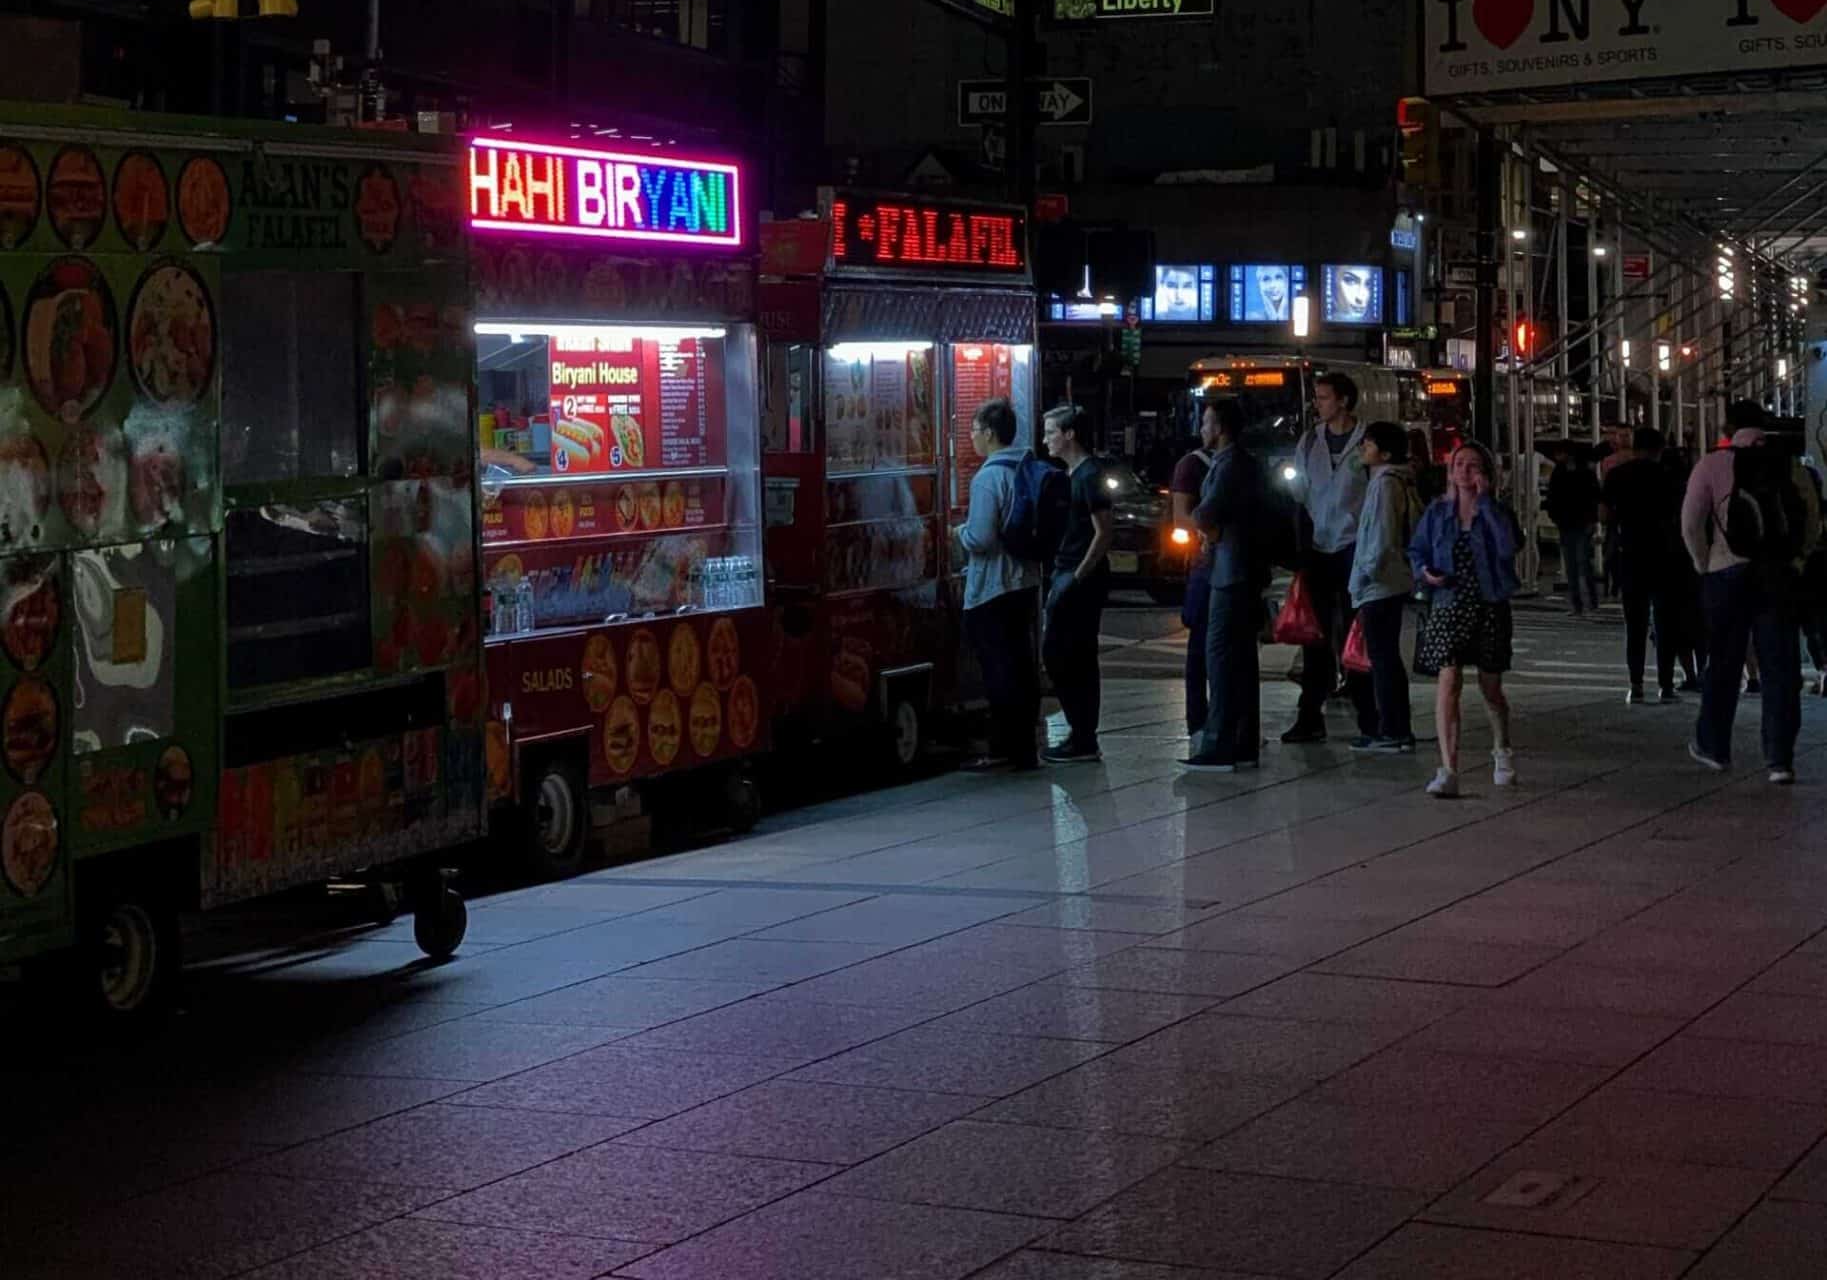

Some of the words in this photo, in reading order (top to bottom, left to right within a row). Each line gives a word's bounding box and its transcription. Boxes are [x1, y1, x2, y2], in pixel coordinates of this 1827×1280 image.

[1496, 54, 1577, 74] SOUVENIRS
[1583, 55, 1593, 66] &
[1598, 47, 1657, 65] SPORTS
[979, 95, 1002, 111] ON
[469, 147, 566, 222] HAHI
[576, 159, 727, 233] BIRYANI
[248, 214, 347, 249] FALAFEL
[552, 361, 596, 389] Biryani
[598, 361, 638, 385] House
[521, 667, 574, 693] SALADS
